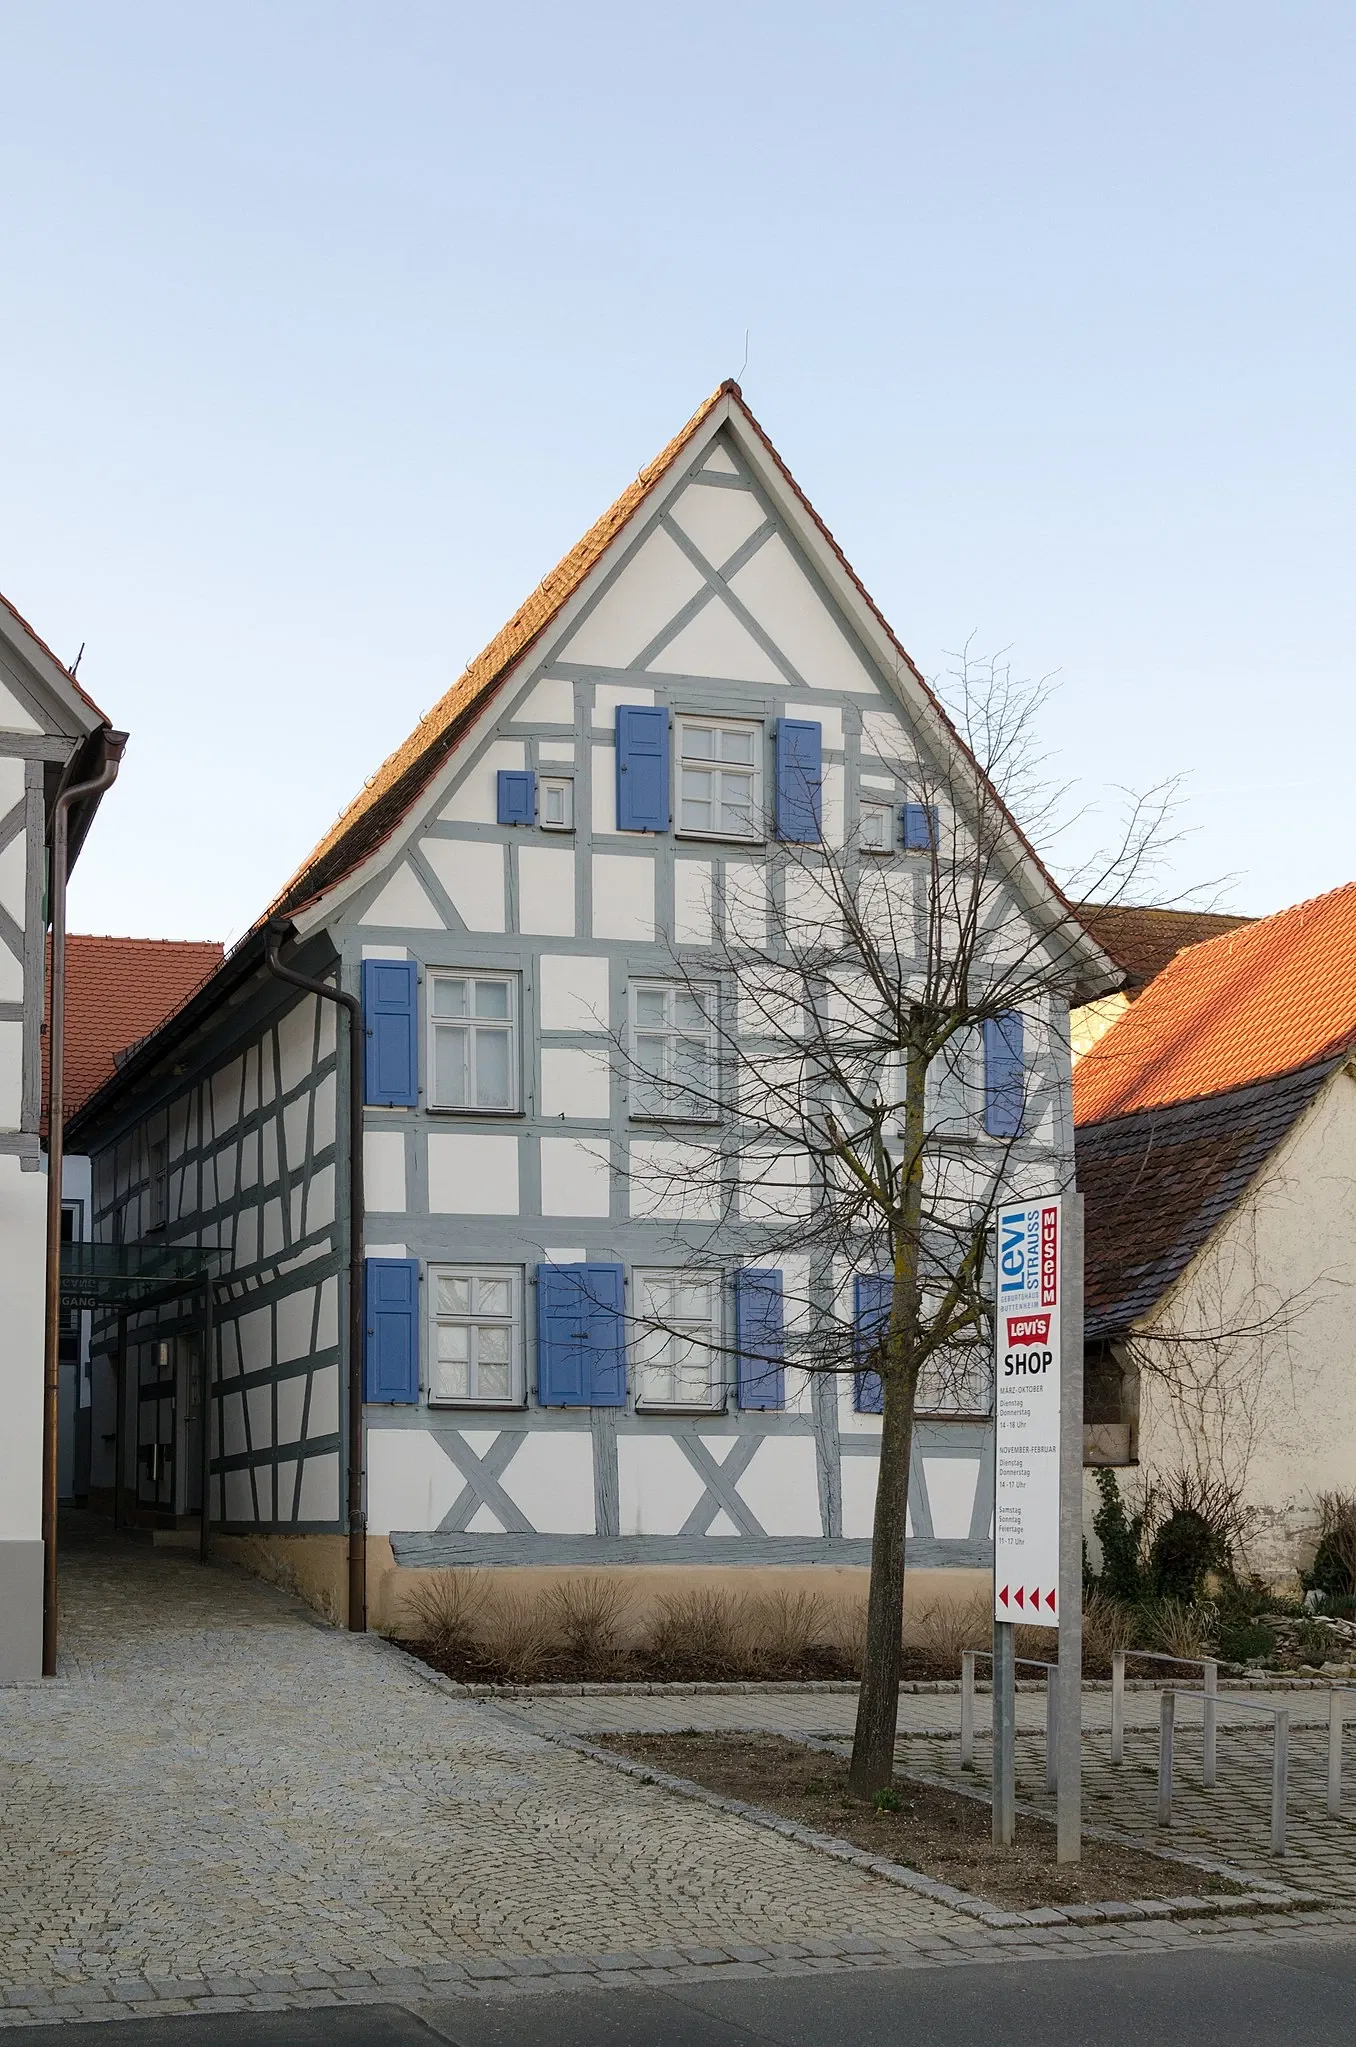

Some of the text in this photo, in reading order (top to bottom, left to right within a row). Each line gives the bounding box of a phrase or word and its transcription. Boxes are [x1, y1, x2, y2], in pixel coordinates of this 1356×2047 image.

[1027, 1210, 1040, 1290] STRAUSS
[61, 1296, 97, 1307] GANG
[1001, 1292, 1039, 1303] GEBURTSHAUS
[1000, 1301, 1039, 1312] BUTTENHEIM
[1004, 1351, 1053, 1376] SHOP
[1000, 1400, 1023, 1408] Dienstag
[1000, 1409, 1031, 1417] Donnerstag
[1000, 1459, 1022, 1468] Dienstag
[1000, 1469, 1030, 1477] Donnerstag
[999, 1506, 1021, 1515] Samstag
[999, 1515, 1021, 1525] Sonntag
[999, 1525, 1024, 1534] Feiertage
[1015, 1537, 1025, 1545] Uhr
